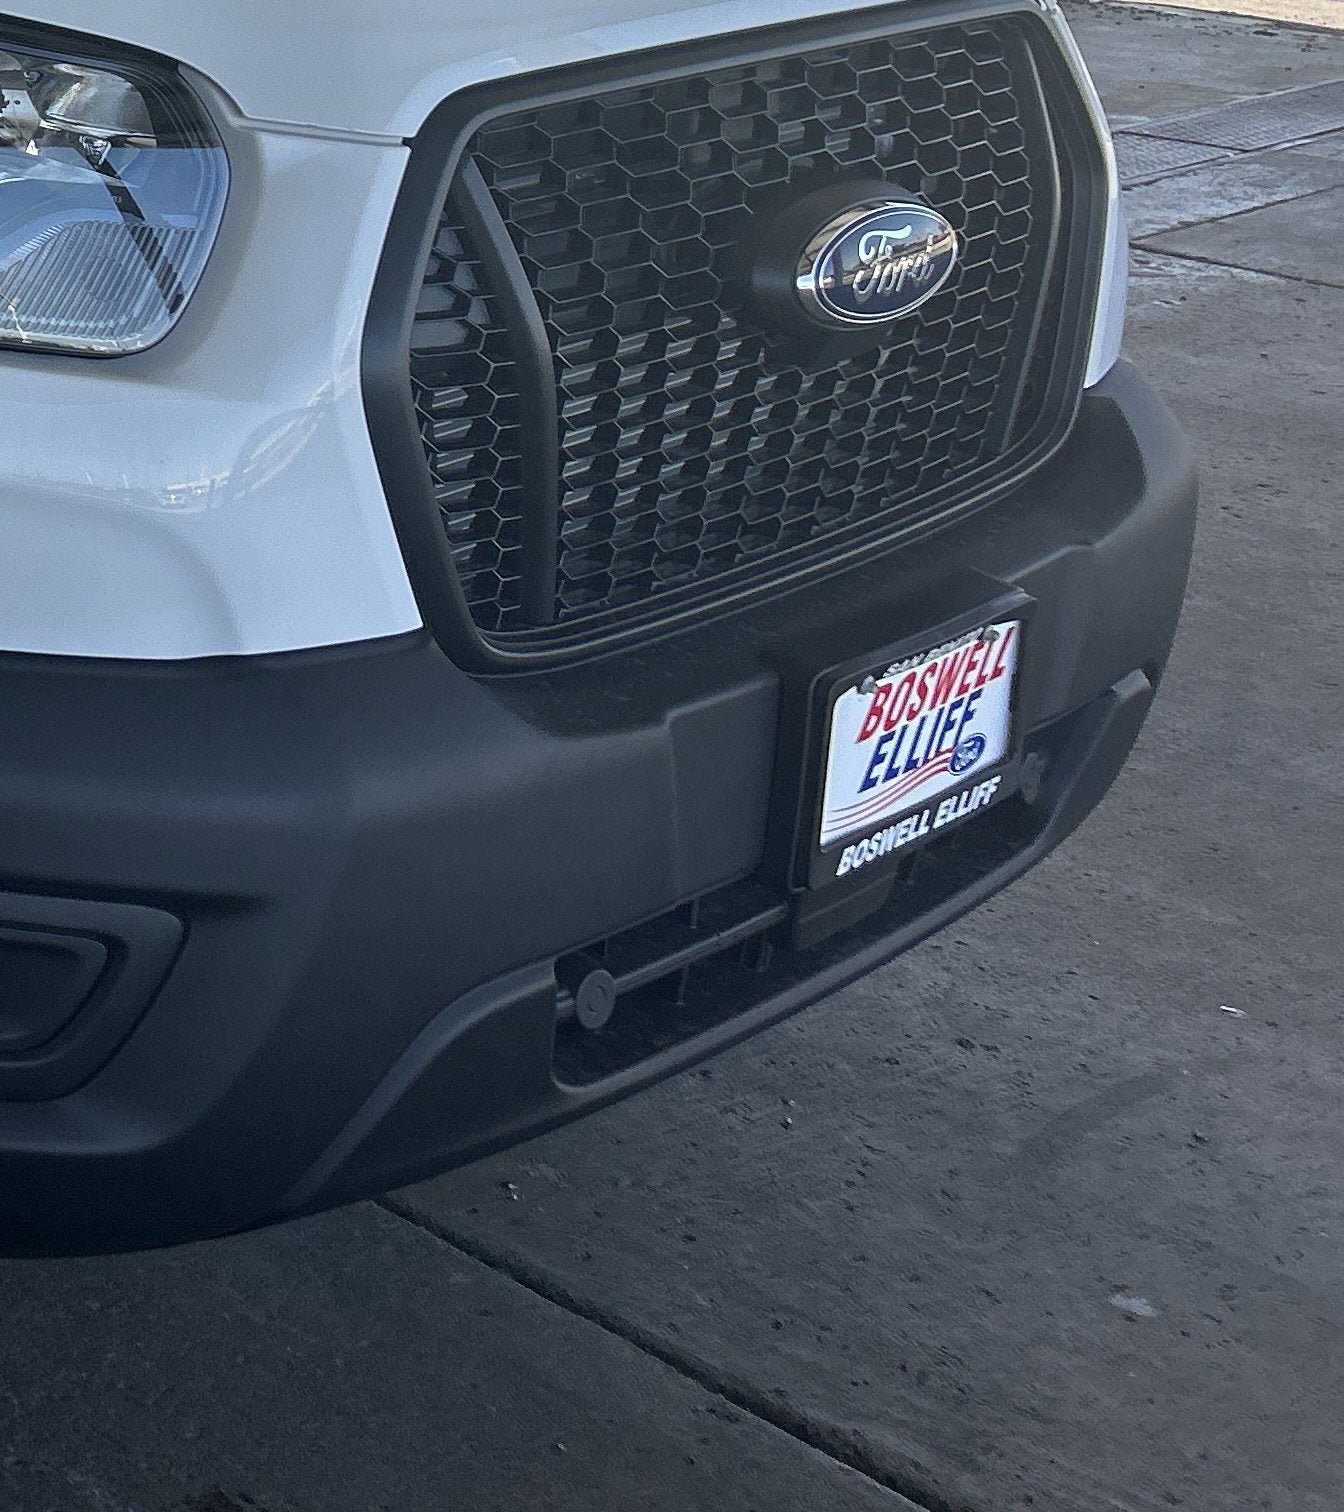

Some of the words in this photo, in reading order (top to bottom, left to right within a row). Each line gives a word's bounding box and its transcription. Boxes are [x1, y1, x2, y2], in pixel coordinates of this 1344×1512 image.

[853, 224, 935, 294] Ford
[854, 626, 1016, 744] BOSWELL
[857, 688, 983, 794] ELLIFF
[835, 808, 931, 877] BOSWELL
[933, 774, 1002, 829] ELLIFF
